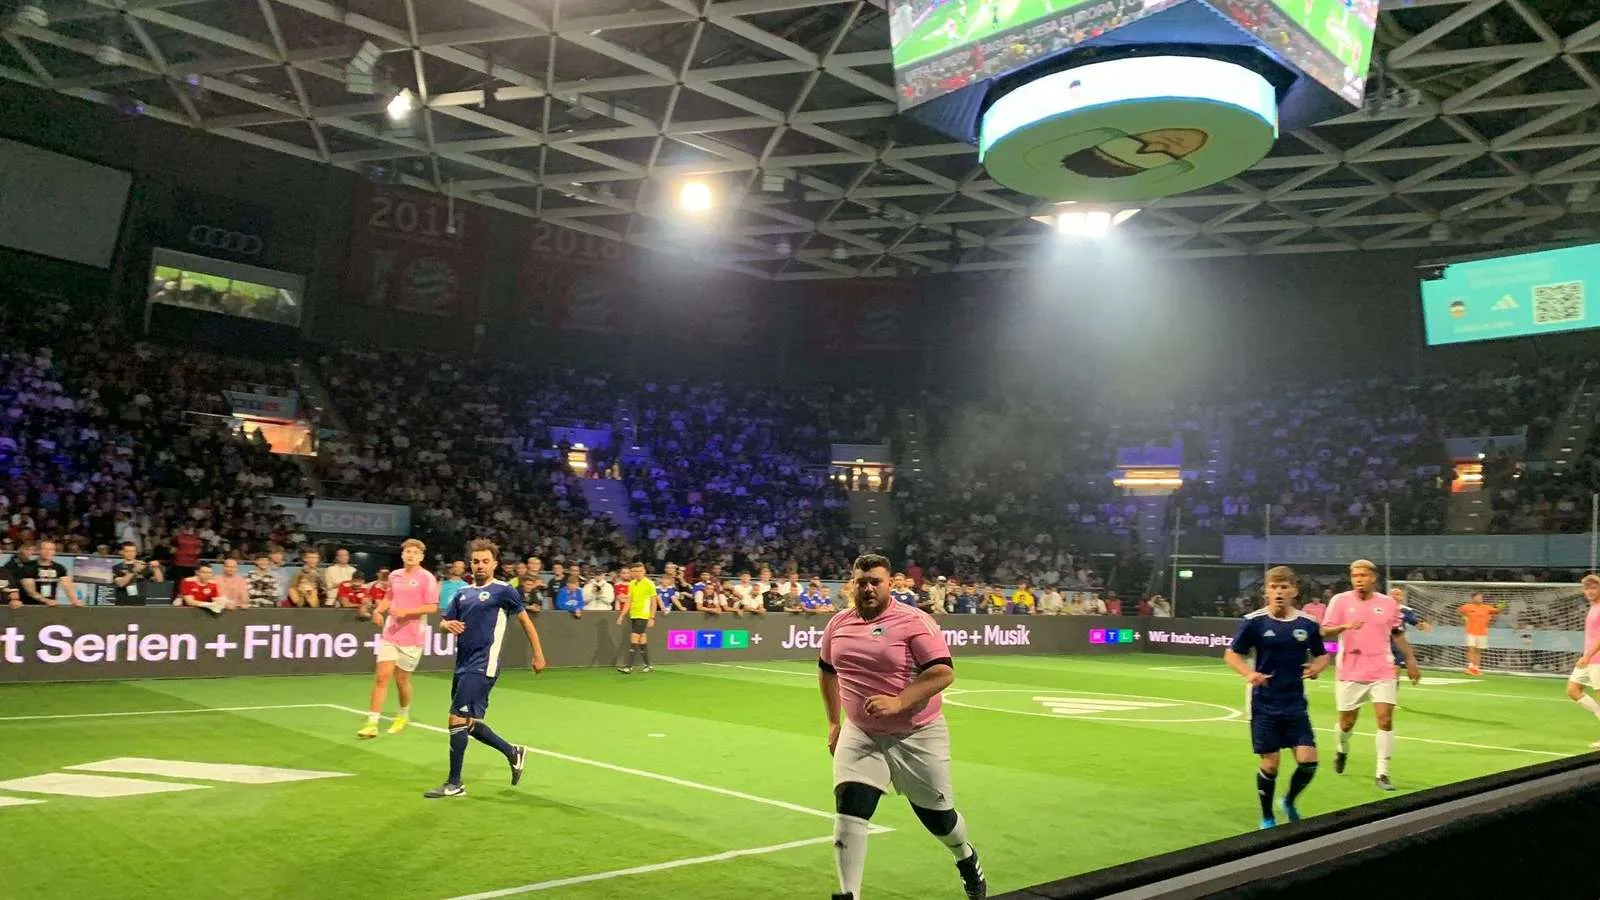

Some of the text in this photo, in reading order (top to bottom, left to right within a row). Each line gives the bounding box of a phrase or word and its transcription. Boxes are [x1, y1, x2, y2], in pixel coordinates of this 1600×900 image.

[36, 624, 197, 663] Serien
[243, 624, 358, 660] Filme
[984, 624, 1031, 646] Musik
[1148, 630, 1170, 643] Wir
[1171, 632, 1209, 645] haben
